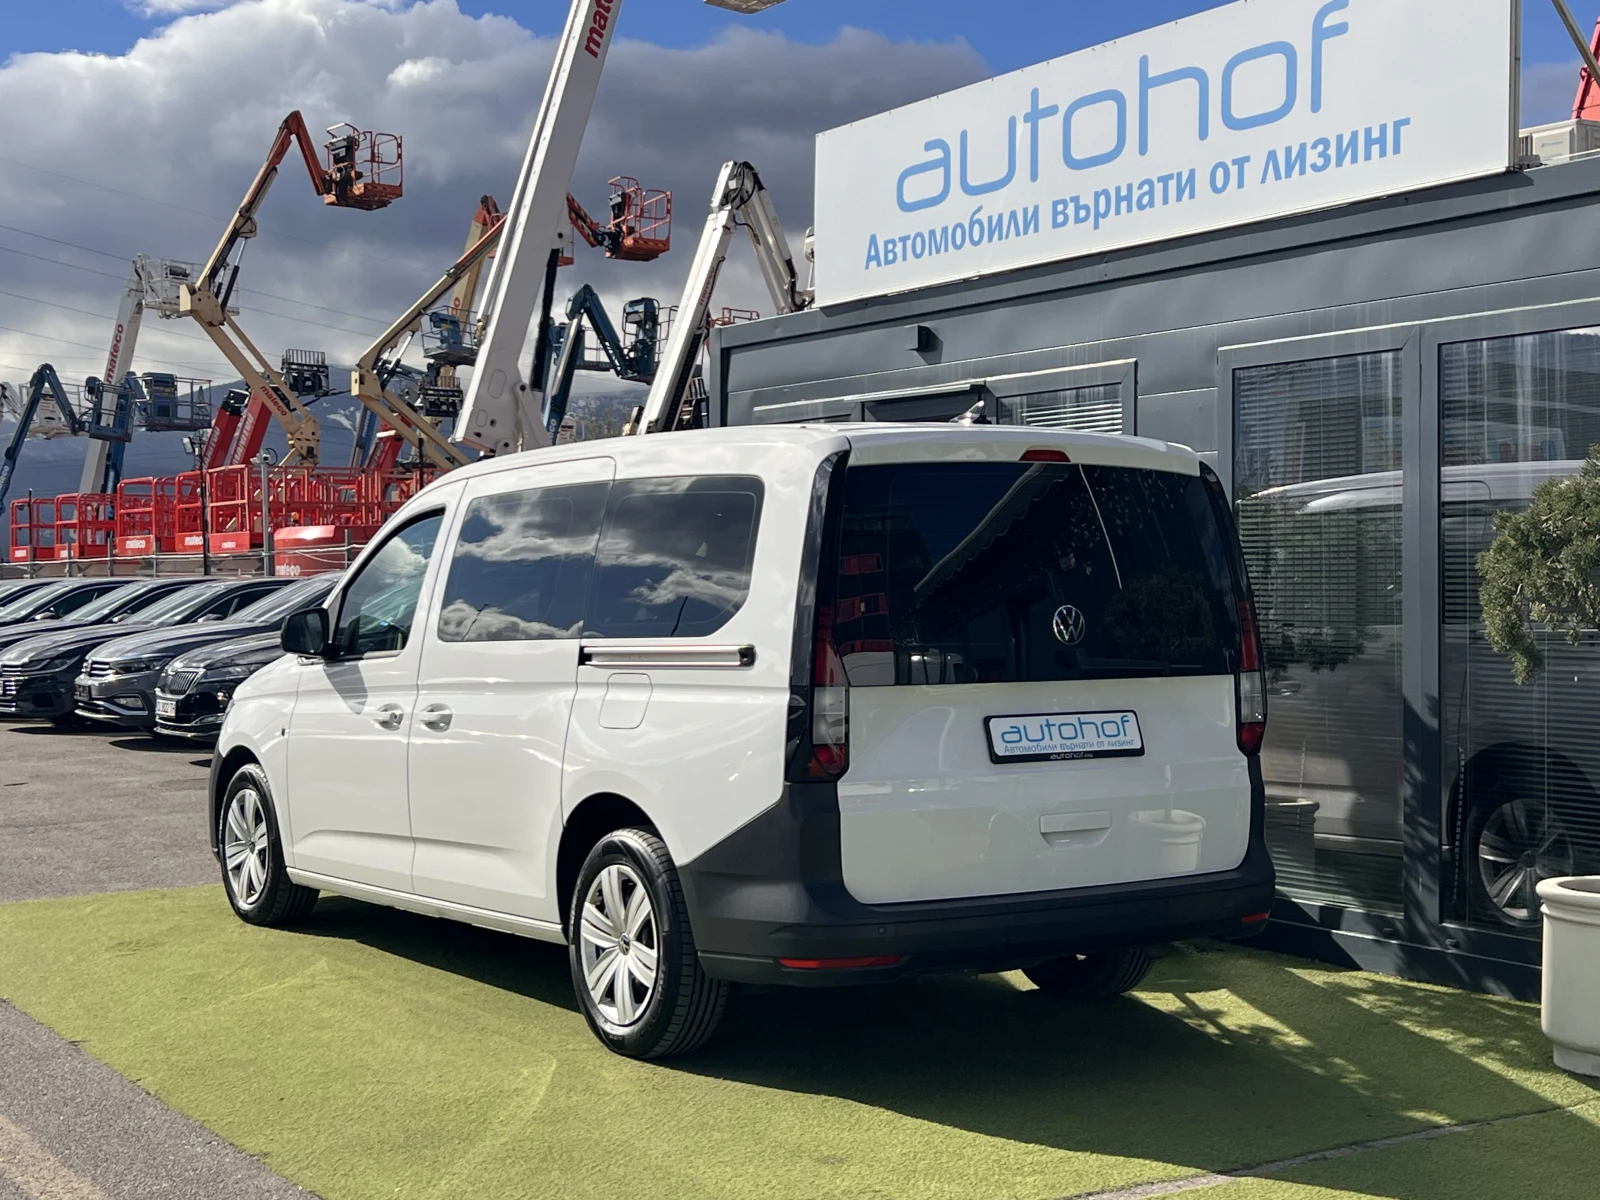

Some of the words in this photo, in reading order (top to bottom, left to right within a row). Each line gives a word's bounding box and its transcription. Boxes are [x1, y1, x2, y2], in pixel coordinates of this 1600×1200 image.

[584, 0, 614, 58] mat
[896, 0, 1350, 213] autohof
[864, 207, 1041, 270] Автомобили
[1051, 168, 1197, 230] върнати
[1209, 155, 1252, 195] от
[1260, 117, 1411, 185] лизинг
[106, 323, 124, 385] mateco
[260, 385, 287, 417] mateco
[1001, 715, 1130, 743] autohof
[1004, 743, 1057, 753] Автомобили
[1060, 740, 1095, 752] върнати
[1097, 740, 1105, 748] от
[1107, 739, 1135, 748] лизинг
